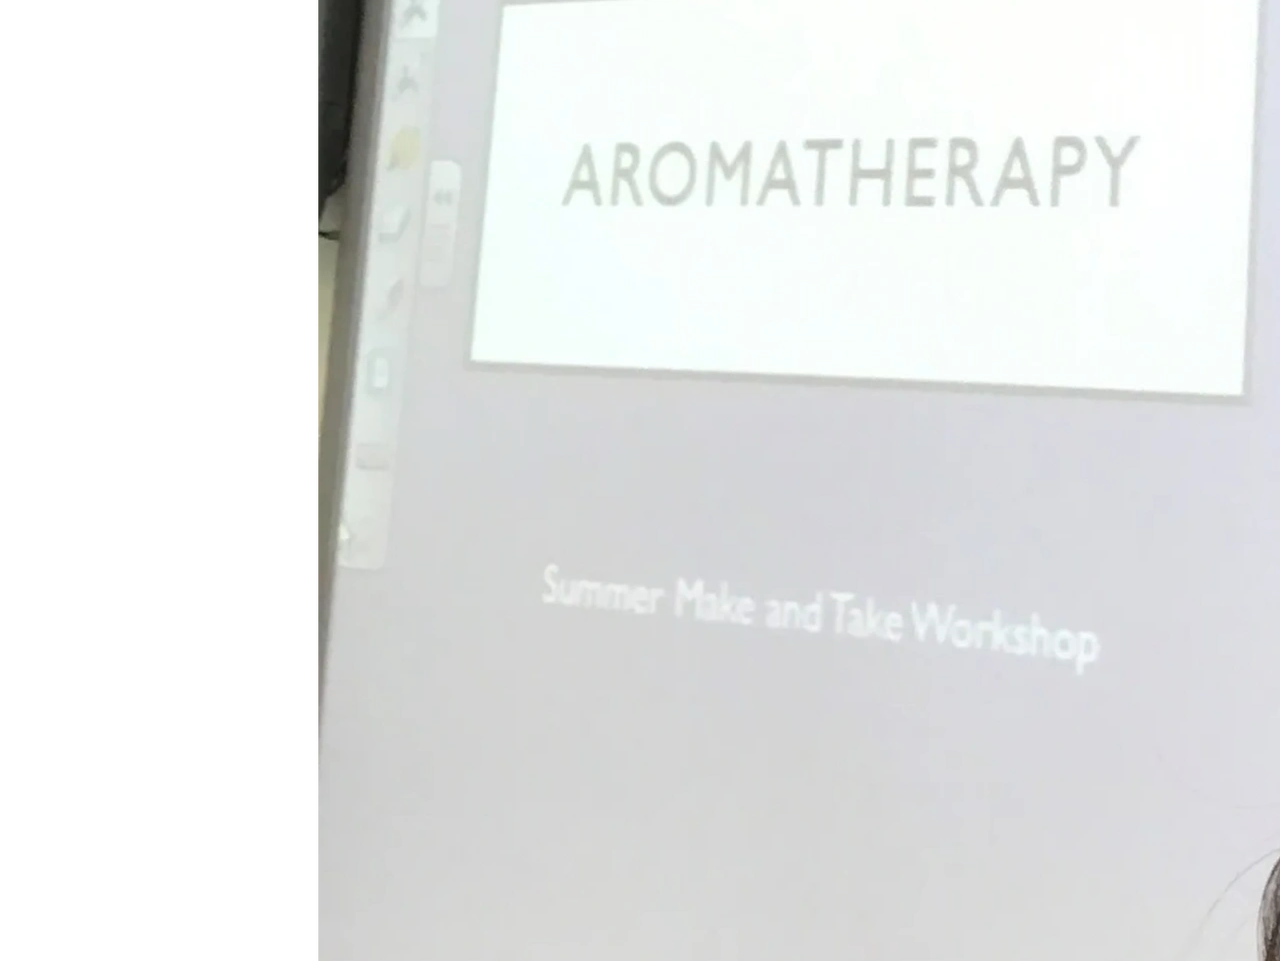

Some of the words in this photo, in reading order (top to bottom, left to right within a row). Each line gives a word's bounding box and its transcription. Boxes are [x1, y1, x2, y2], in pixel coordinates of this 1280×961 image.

[561, 135, 1141, 207] AROMATHERAPY
[541, 564, 664, 615] Summer
[673, 577, 755, 626] Make
[765, 593, 823, 632] and
[830, 591, 903, 641] Take
[911, 600, 1101, 675] Workshop
